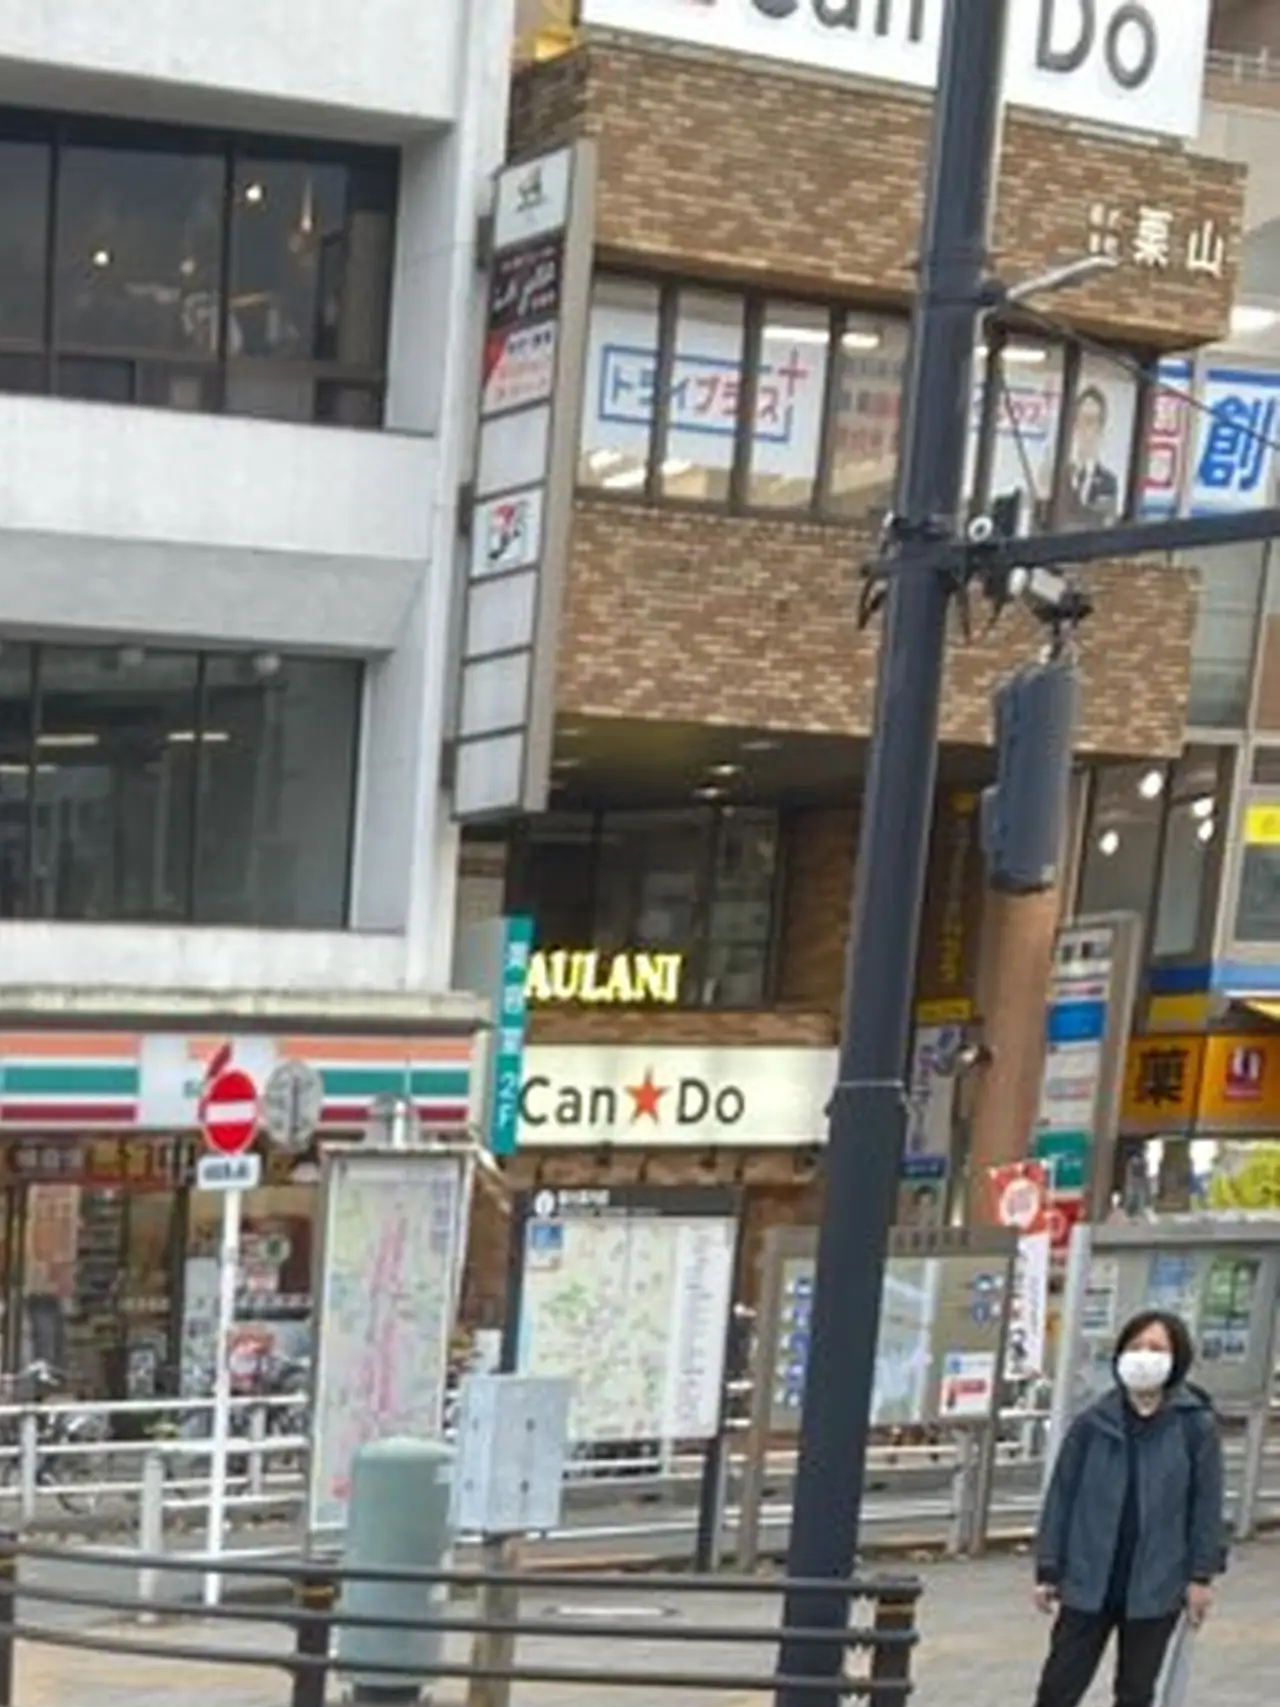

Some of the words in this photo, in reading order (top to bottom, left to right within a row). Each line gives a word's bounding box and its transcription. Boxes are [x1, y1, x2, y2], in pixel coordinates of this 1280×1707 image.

[1035, 0, 1159, 90] Do
[523, 949, 683, 1002] AULANI
[519, 1075, 617, 1126] Can
[676, 1076, 745, 1125] Do
